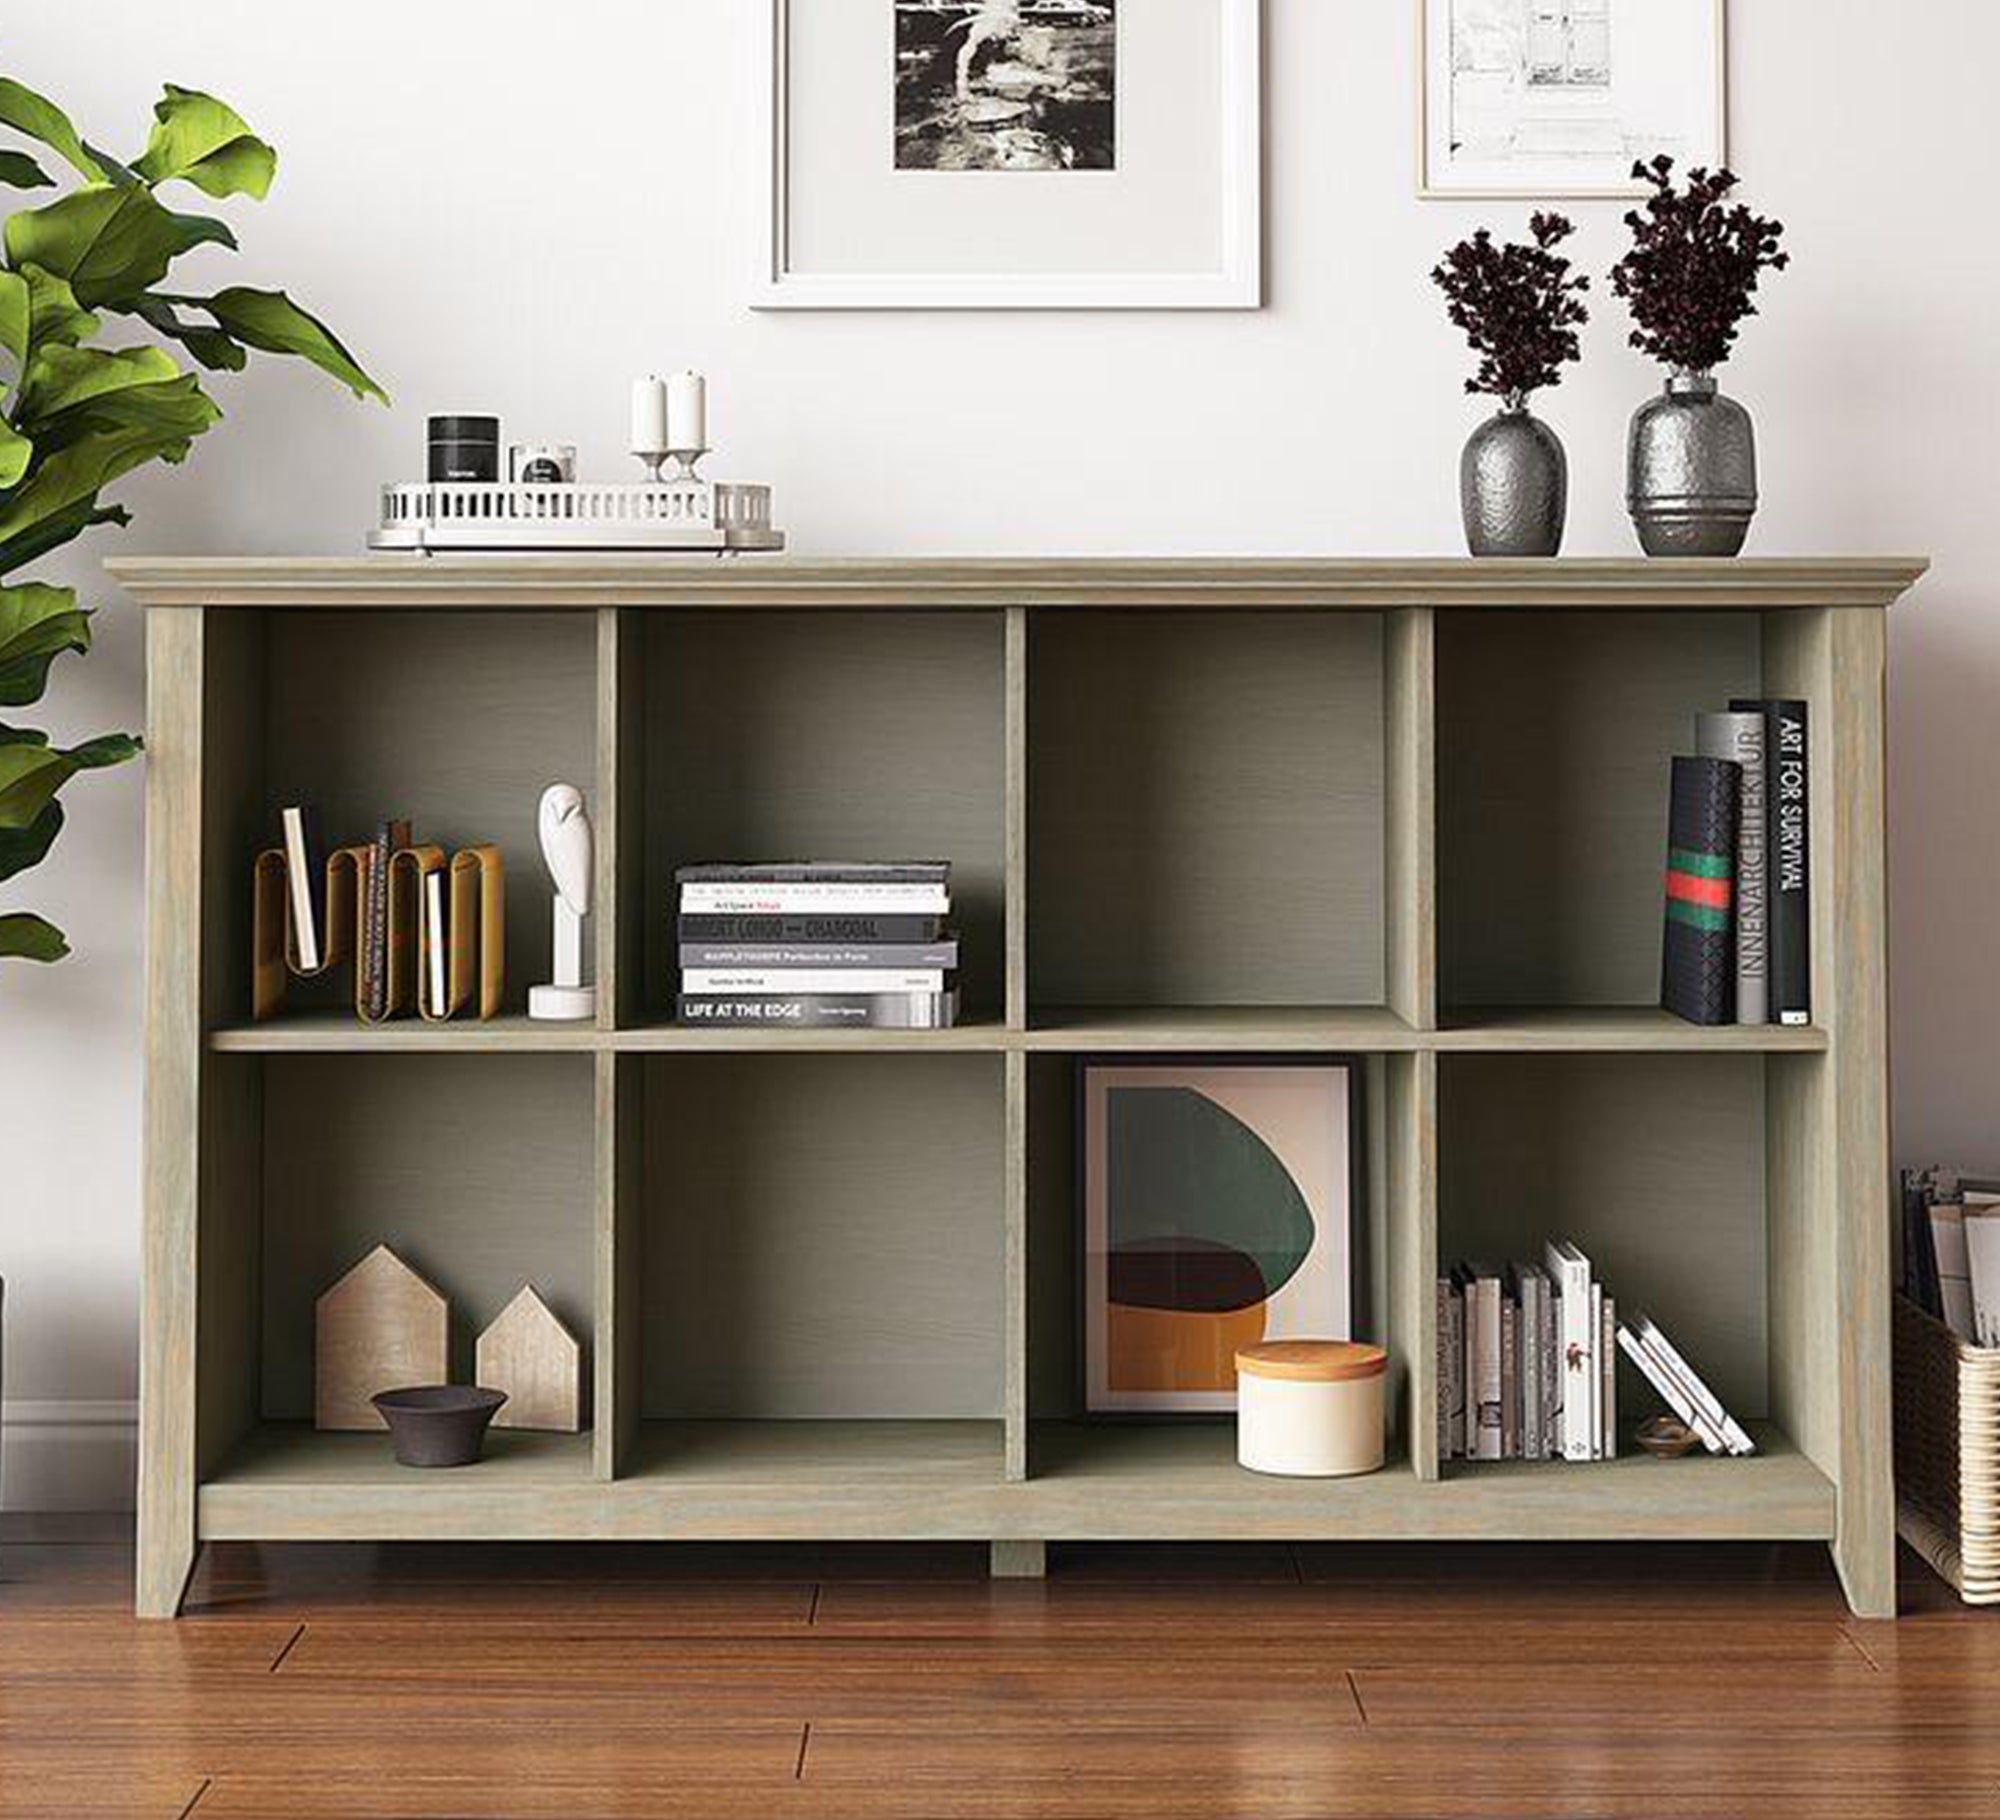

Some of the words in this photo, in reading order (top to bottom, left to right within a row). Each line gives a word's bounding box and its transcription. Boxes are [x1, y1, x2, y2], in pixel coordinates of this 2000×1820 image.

[1780, 718, 1803, 754] ART
[1780, 760, 1803, 800] FOR
[1737, 730, 1763, 979] INNENARCHITEKTUR
[1780, 804, 1803, 891] SURVIVAL
[685, 1003, 712, 1017] LIFE
[716, 1003, 734, 1017] AT
[736, 1003, 762, 1017] THE
[764, 1003, 801, 1017] EDGE
